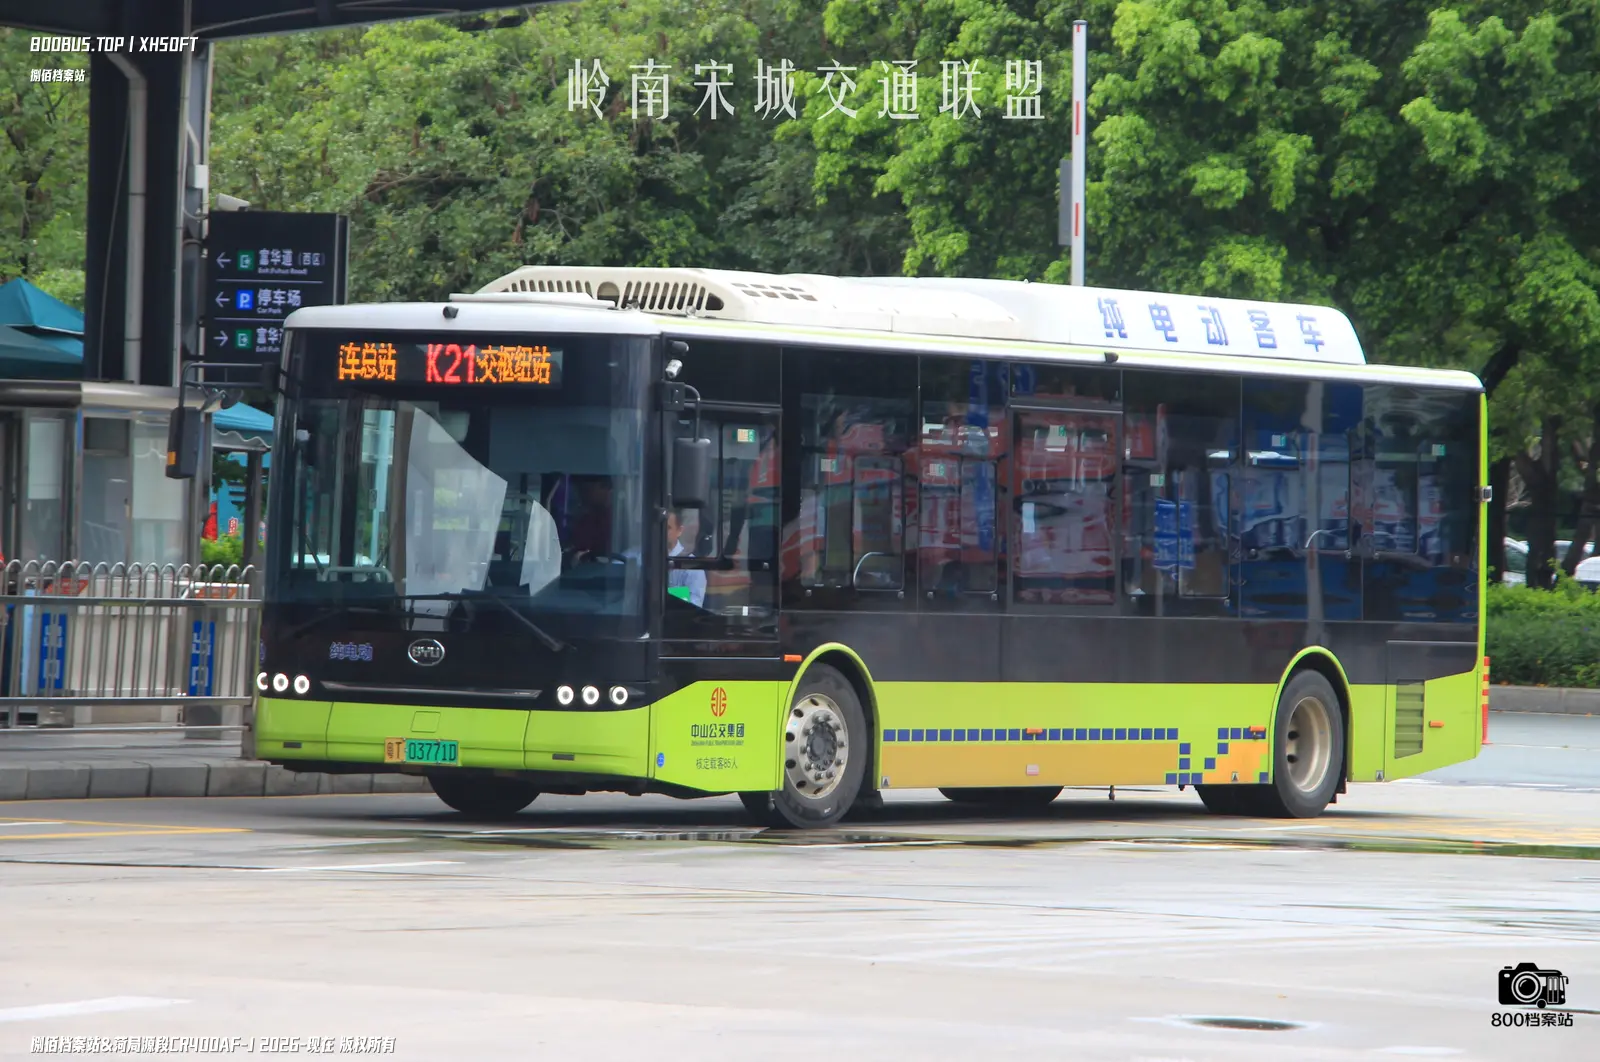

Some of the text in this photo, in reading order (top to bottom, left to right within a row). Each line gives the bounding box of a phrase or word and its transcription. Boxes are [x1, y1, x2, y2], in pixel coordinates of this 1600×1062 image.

[258, 288, 302, 307] 停车场
[1097, 297, 1326, 352] 纯电动客车
[427, 344, 475, 383] K21
[329, 641, 373, 661] 纯电动
[691, 723, 744, 738] 中山公交集团
